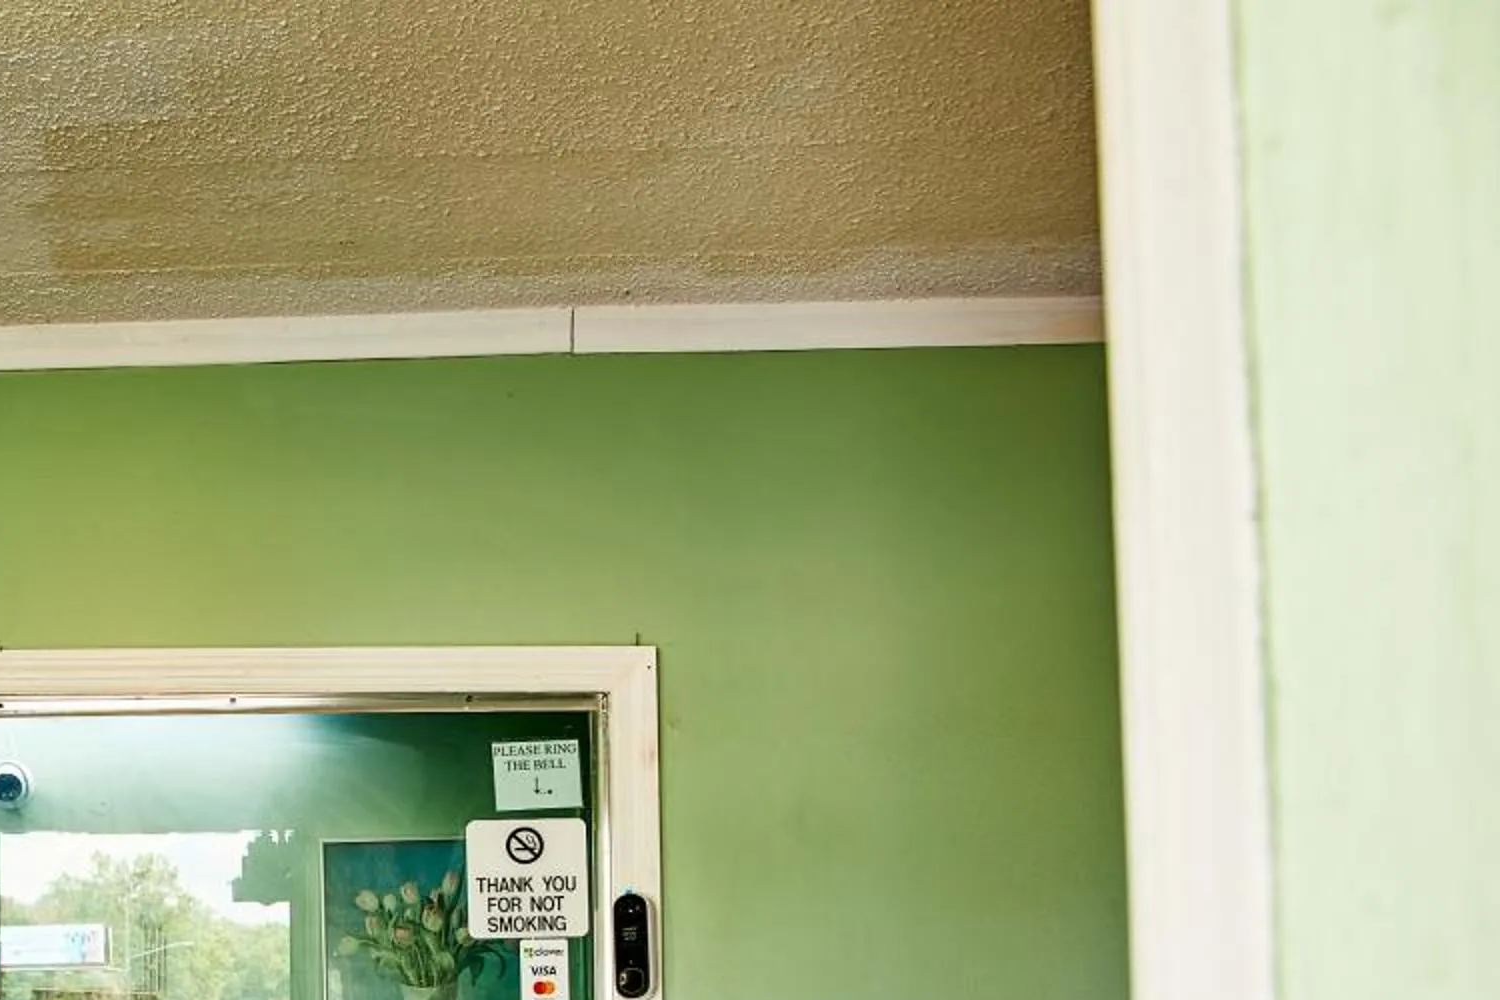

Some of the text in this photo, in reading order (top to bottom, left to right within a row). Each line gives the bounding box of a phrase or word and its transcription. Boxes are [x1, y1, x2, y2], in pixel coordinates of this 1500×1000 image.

[494, 743, 576, 756] PLEASE RING
[504, 759, 567, 772] THE BELL
[476, 875, 577, 893] THANK YOU
[487, 895, 565, 913] FOR NOT
[487, 915, 567, 933] SMOKING
[531, 965, 557, 976] VISA
